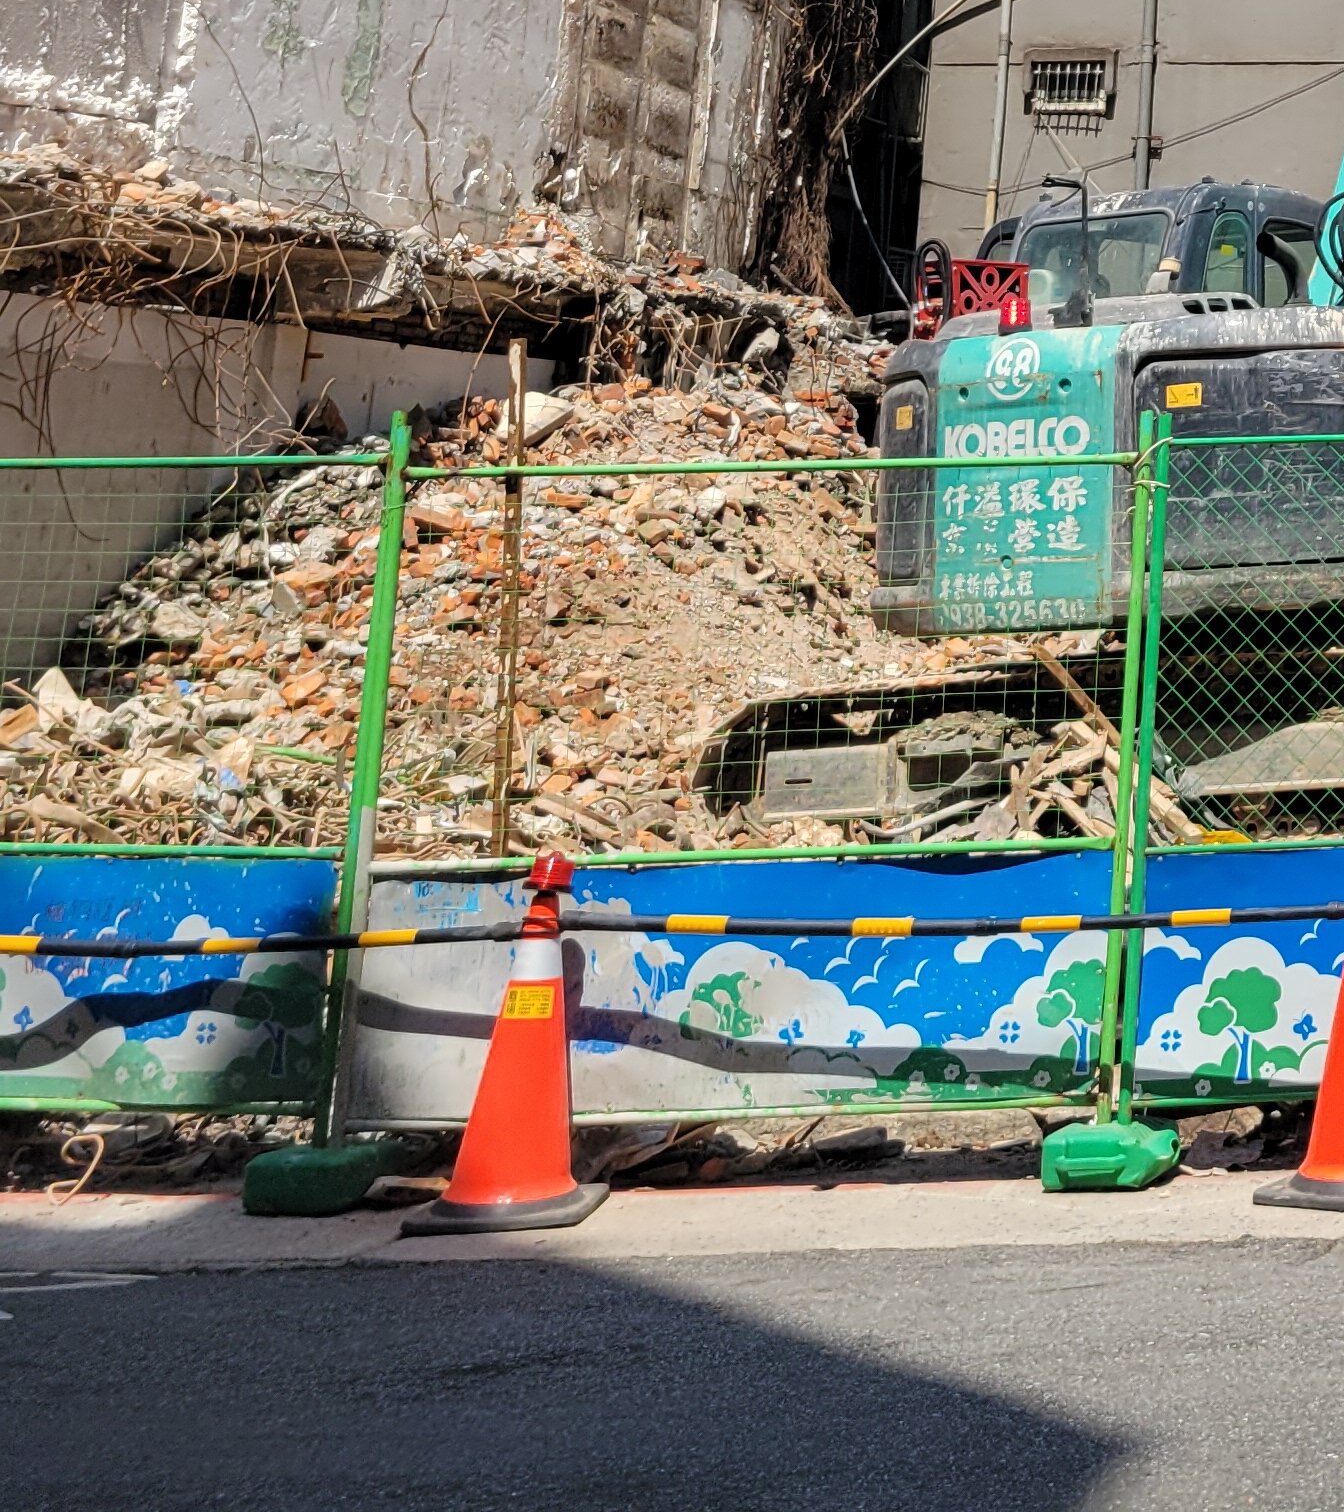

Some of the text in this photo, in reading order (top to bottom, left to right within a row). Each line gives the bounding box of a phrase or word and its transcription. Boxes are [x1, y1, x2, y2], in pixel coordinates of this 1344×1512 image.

[944, 415, 1091, 458] KOBELCO
[942, 475, 1089, 520] 仟溢環保
